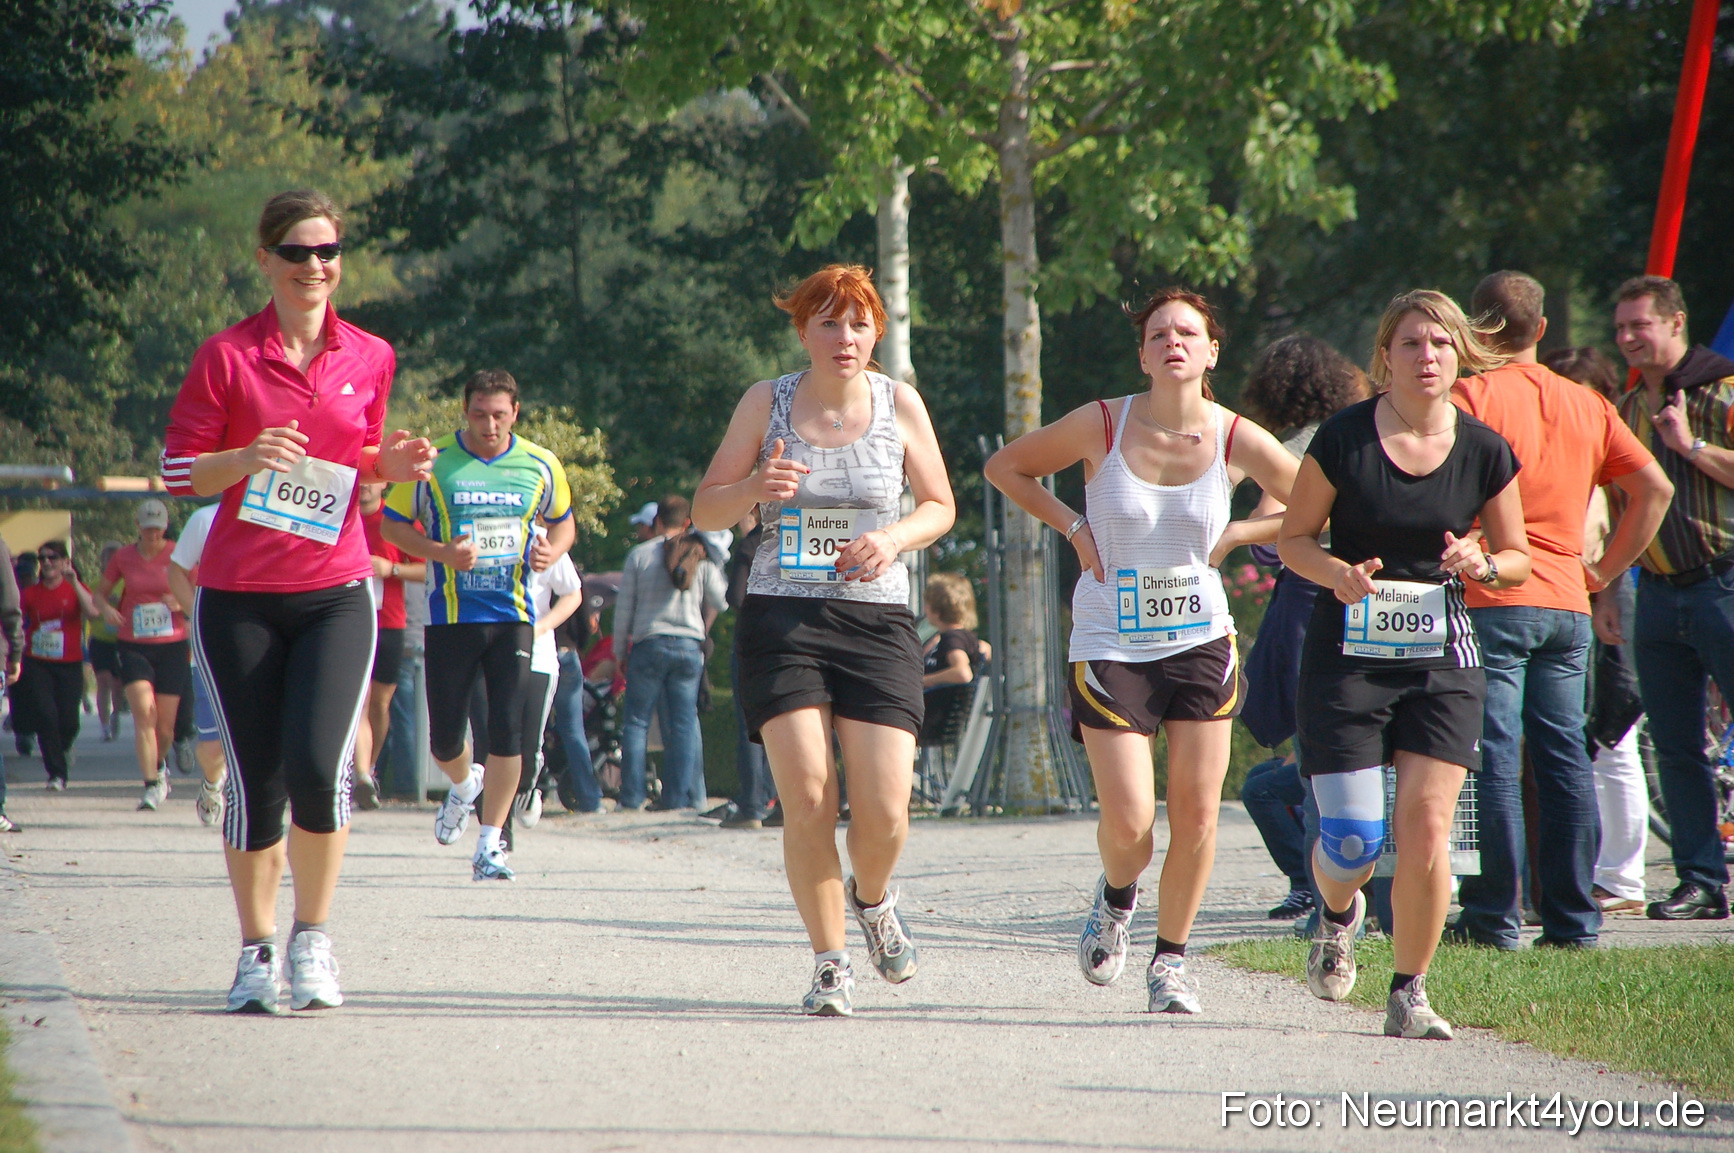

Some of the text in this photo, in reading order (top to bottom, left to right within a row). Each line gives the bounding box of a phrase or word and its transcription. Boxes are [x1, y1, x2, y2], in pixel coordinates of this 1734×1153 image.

[277, 482, 337, 514] 6092
[453, 491, 523, 506] BOCK
[807, 516, 849, 529] Andrea
[480, 536, 515, 549] 3673
[786, 536, 792, 546] D
[1143, 576, 1200, 590] Christiane
[1375, 588, 1420, 603] Melanie
[1124, 598, 1130, 608] D
[1146, 595, 1201, 617] 3078
[1353, 609, 1359, 619] D
[1376, 611, 1434, 633] 3099
